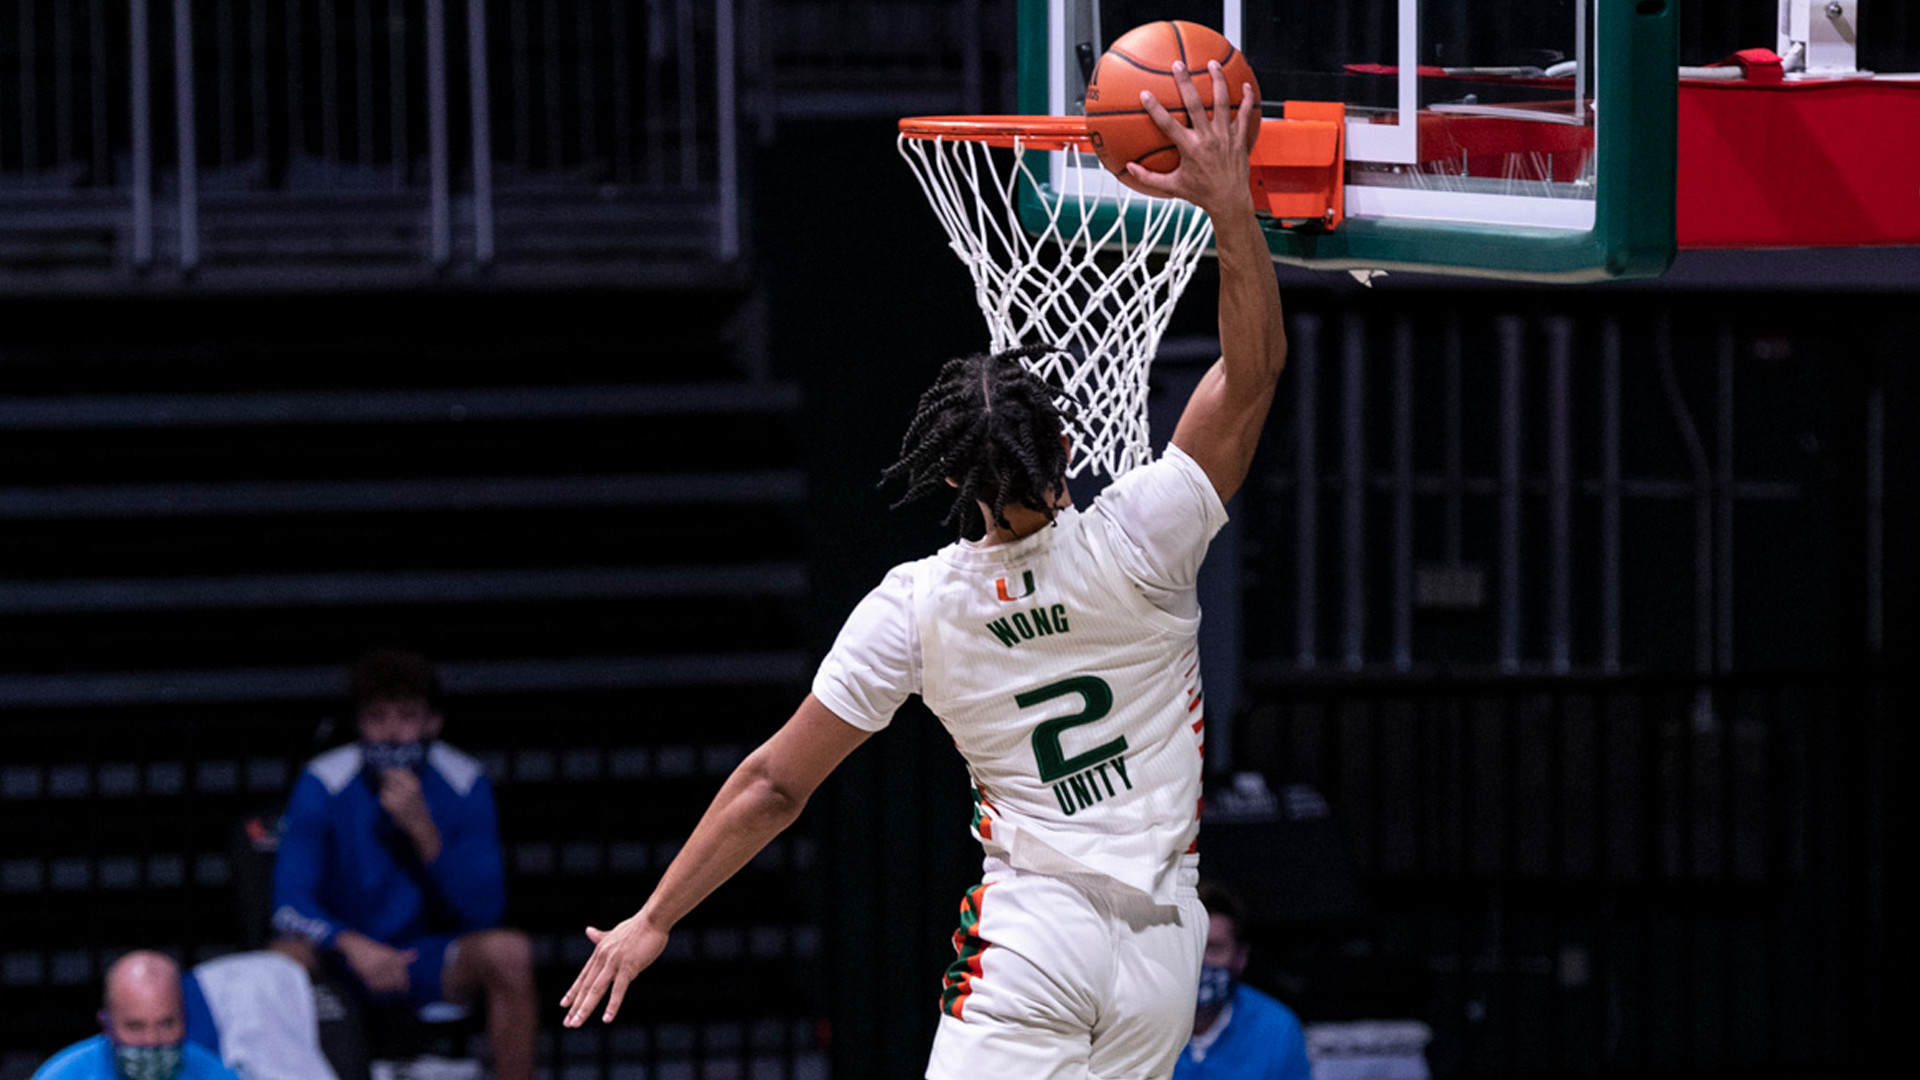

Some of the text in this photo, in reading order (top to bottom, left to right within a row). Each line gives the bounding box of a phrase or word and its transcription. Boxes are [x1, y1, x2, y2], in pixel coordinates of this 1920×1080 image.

[995, 570, 1036, 602] U
[985, 603, 1070, 648] WONG
[1014, 675, 1129, 784] 2
[1053, 756, 1133, 816] UNITY
